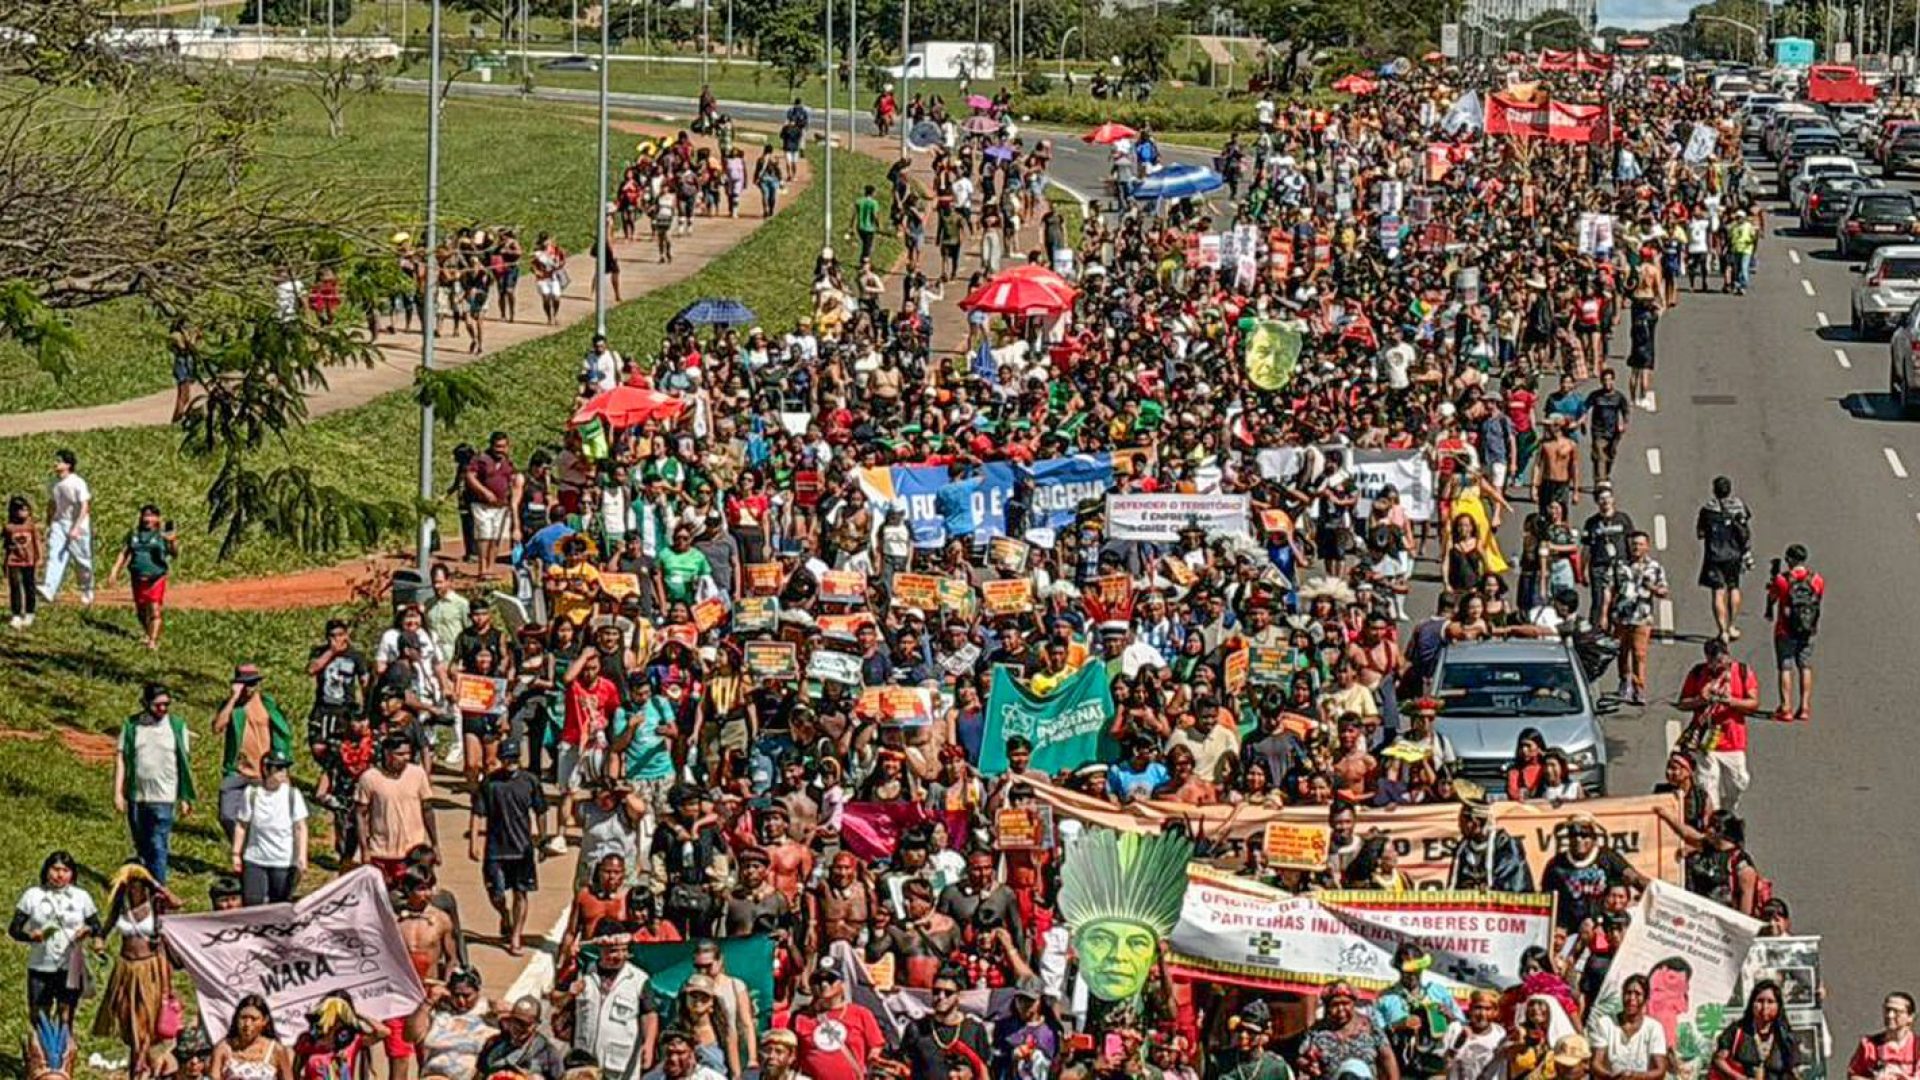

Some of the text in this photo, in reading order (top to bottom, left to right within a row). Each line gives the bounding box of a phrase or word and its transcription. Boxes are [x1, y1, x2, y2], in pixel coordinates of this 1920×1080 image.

[1114, 499, 1242, 510] DEFENDER O TERRITÓRIO
[1150, 512, 1213, 521] ENFREAR
[1210, 910, 1306, 931] PARTEIRAS
[1400, 915, 1478, 931] SABERES
[1485, 917, 1526, 934] COM
[259, 955, 335, 997] WARA
